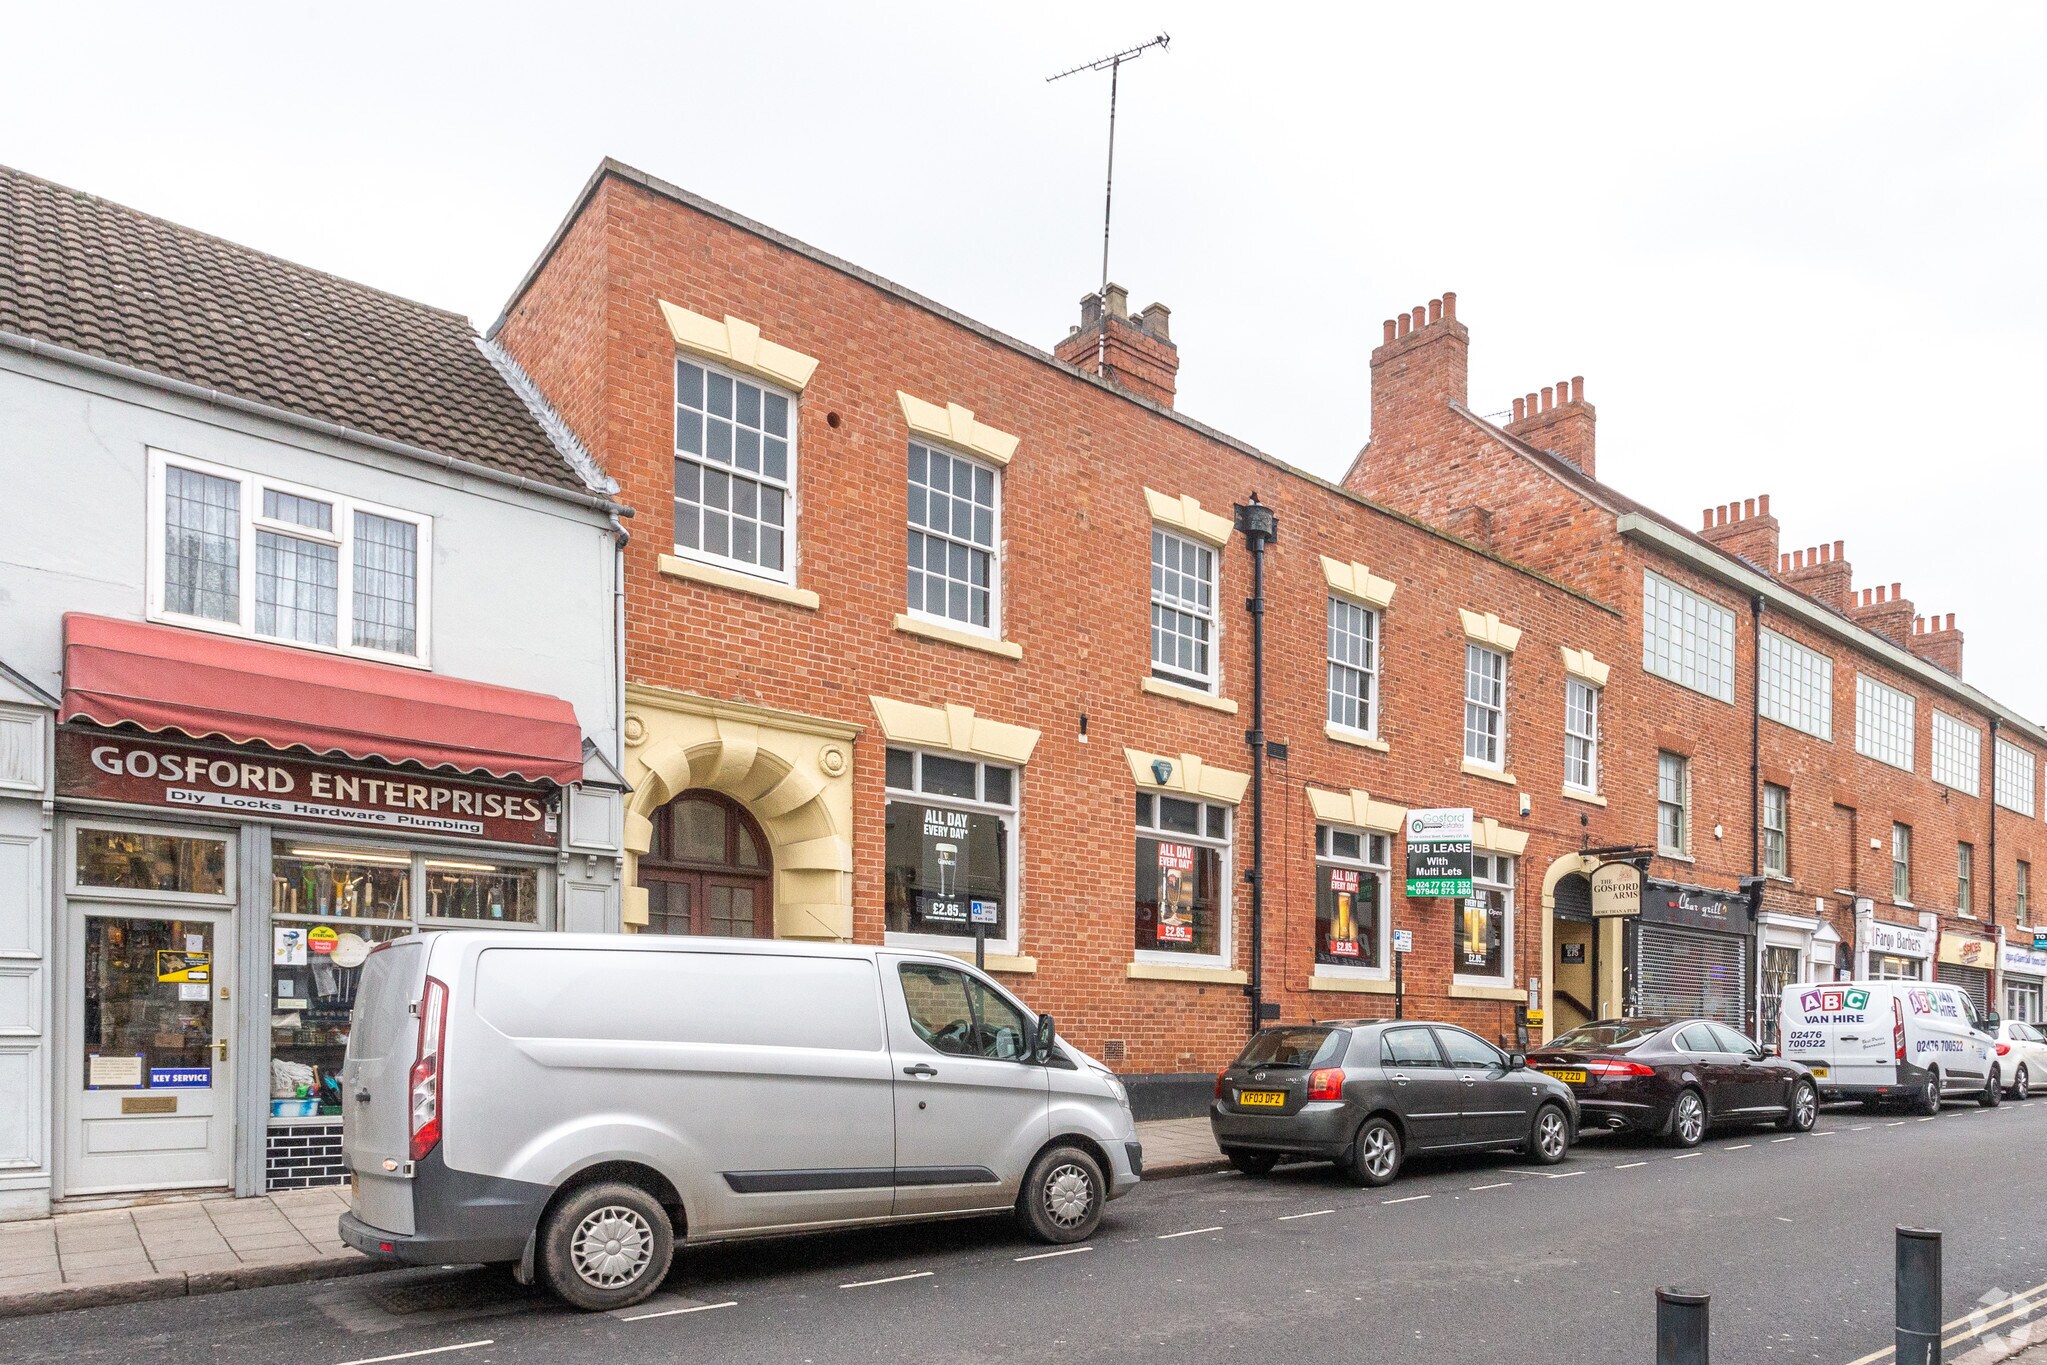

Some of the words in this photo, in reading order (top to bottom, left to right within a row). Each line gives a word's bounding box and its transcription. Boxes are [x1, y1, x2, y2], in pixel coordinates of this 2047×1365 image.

[91, 746, 295, 794] GOSFORD
[310, 772, 542, 822] ENTERPRISES
[171, 791, 205, 804] Diy
[221, 796, 282, 811] Locks
[294, 804, 386, 821] Hardware
[397, 815, 481, 833] Plumbing
[1423, 813, 1465, 823] Gosford
[925, 809, 945, 825] ALL
[947, 812, 968, 828] DAY
[923, 824, 948, 838] EVERY
[1160, 843, 1176, 858] ALL
[1176, 846, 1192, 860] DAY
[1407, 844, 1430, 853] PUB
[1433, 844, 1471, 853] LEASE
[1159, 856, 1177, 868] EVERY
[1427, 857, 1448, 866] With
[1332, 869, 1343, 881] ALL
[1345, 871, 1358, 883] DAY
[1416, 867, 1439, 876] Multi
[1441, 867, 1462, 876] Lets
[1593, 883, 1639, 893] GOSFORD
[1612, 891, 1639, 900] ARMS
[932, 903, 959, 917] £2.85
[1488, 908, 1503, 917] Open
[1165, 926, 1185, 938] £2.85
[1875, 927, 1894, 950] Fargo
[1897, 931, 1921, 952] Barbers
[1802, 989, 1867, 1011] ABC
[1909, 989, 1938, 1014] ABC
[1939, 1004, 1958, 1018] HIRE
[1804, 1015, 1829, 1024] VAN
[1833, 1014, 1864, 1023] HIRE
[1790, 1031, 1822, 1039] 02476
[1788, 1040, 1826, 1048] 700522
[1916, 1040, 1940, 1053] 02476
[1941, 1040, 1964, 1052] 700522
[153, 1074, 171, 1082] KEY
[172, 1073, 208, 1082] SERVICE
[1565, 1072, 1581, 1081] ZZD
[1244, 1093, 1264, 1104] KF03
[1265, 1093, 1281, 1104] DFZ
